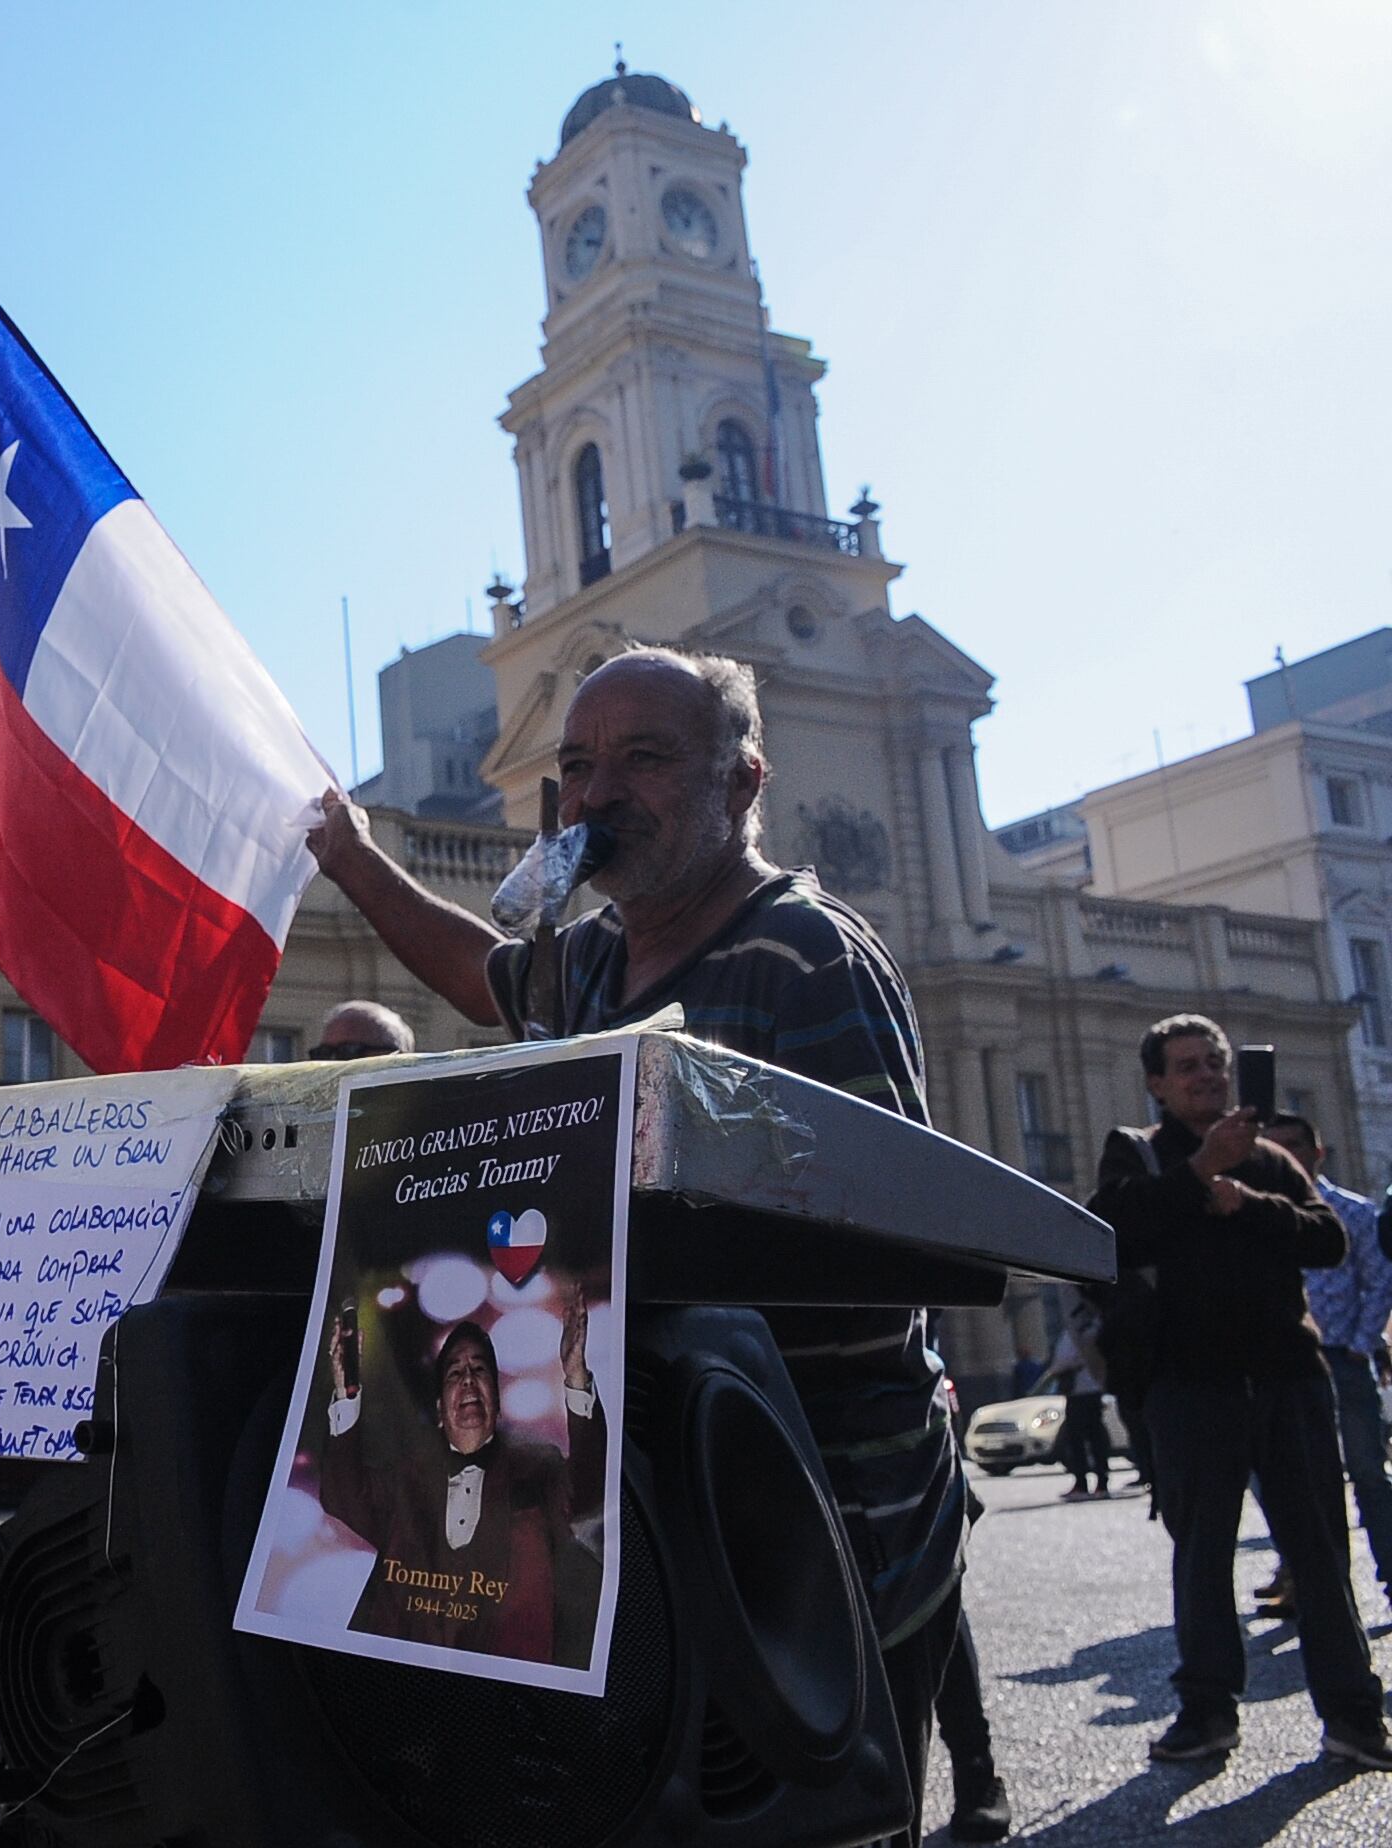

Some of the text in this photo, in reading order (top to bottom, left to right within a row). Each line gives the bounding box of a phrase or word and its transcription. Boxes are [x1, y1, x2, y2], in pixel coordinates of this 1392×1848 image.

[355, 1096, 605, 1170] ¡ÚNICO, GRANDE, NUESTRO!
[73, 1144, 106, 1168] UN
[115, 1137, 171, 1166] GRAN
[395, 1154, 560, 1204] Gracias Tommy
[6, 1212, 36, 1235] UNA
[37, 1249, 124, 1292] COMPRAR
[71, 1290, 125, 1325] SUFR
[14, 1381, 57, 1407] TENER
[384, 1559, 508, 1603] Tommy Rey
[406, 1596, 478, 1620] 1944-2025
